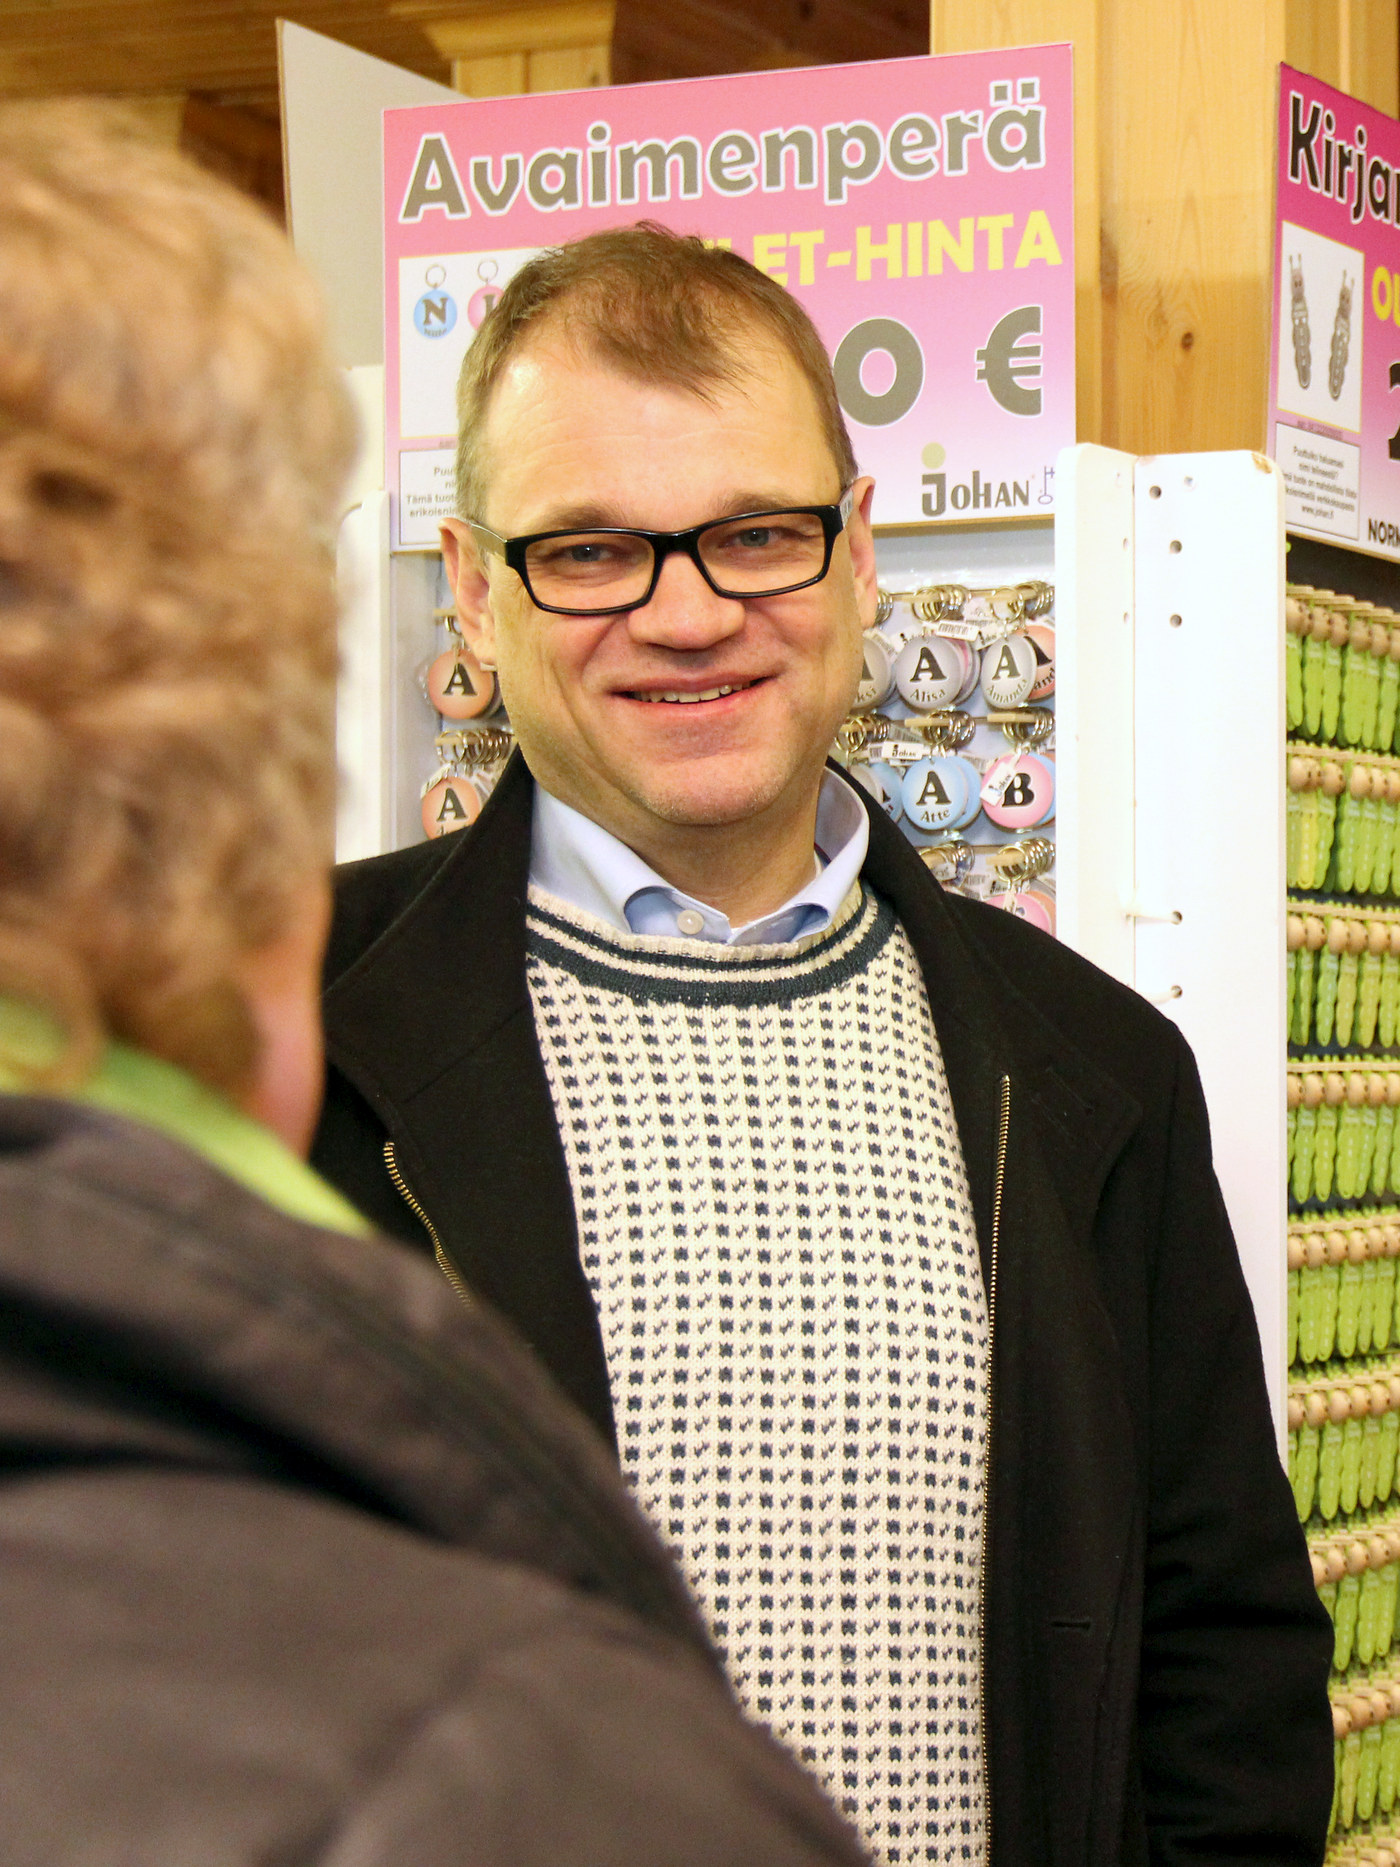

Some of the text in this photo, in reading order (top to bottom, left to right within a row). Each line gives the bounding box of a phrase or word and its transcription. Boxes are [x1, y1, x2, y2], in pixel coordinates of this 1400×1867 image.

[399, 77, 1048, 224] Avaimenperä
[702, 209, 1063, 288] ET-HINTA
[422, 297, 448, 326] N
[833, 305, 1045, 429] 0 €
[442, 662, 478, 697] A
[909, 646, 948, 682] A
[991, 644, 1021, 681] A
[910, 688, 946, 703] Alisa
[986, 677, 1028, 704] Amanda
[436, 787, 468, 822] A
[915, 770, 952, 806] A
[1002, 772, 1035, 808] B
[920, 810, 951, 824] Atte
